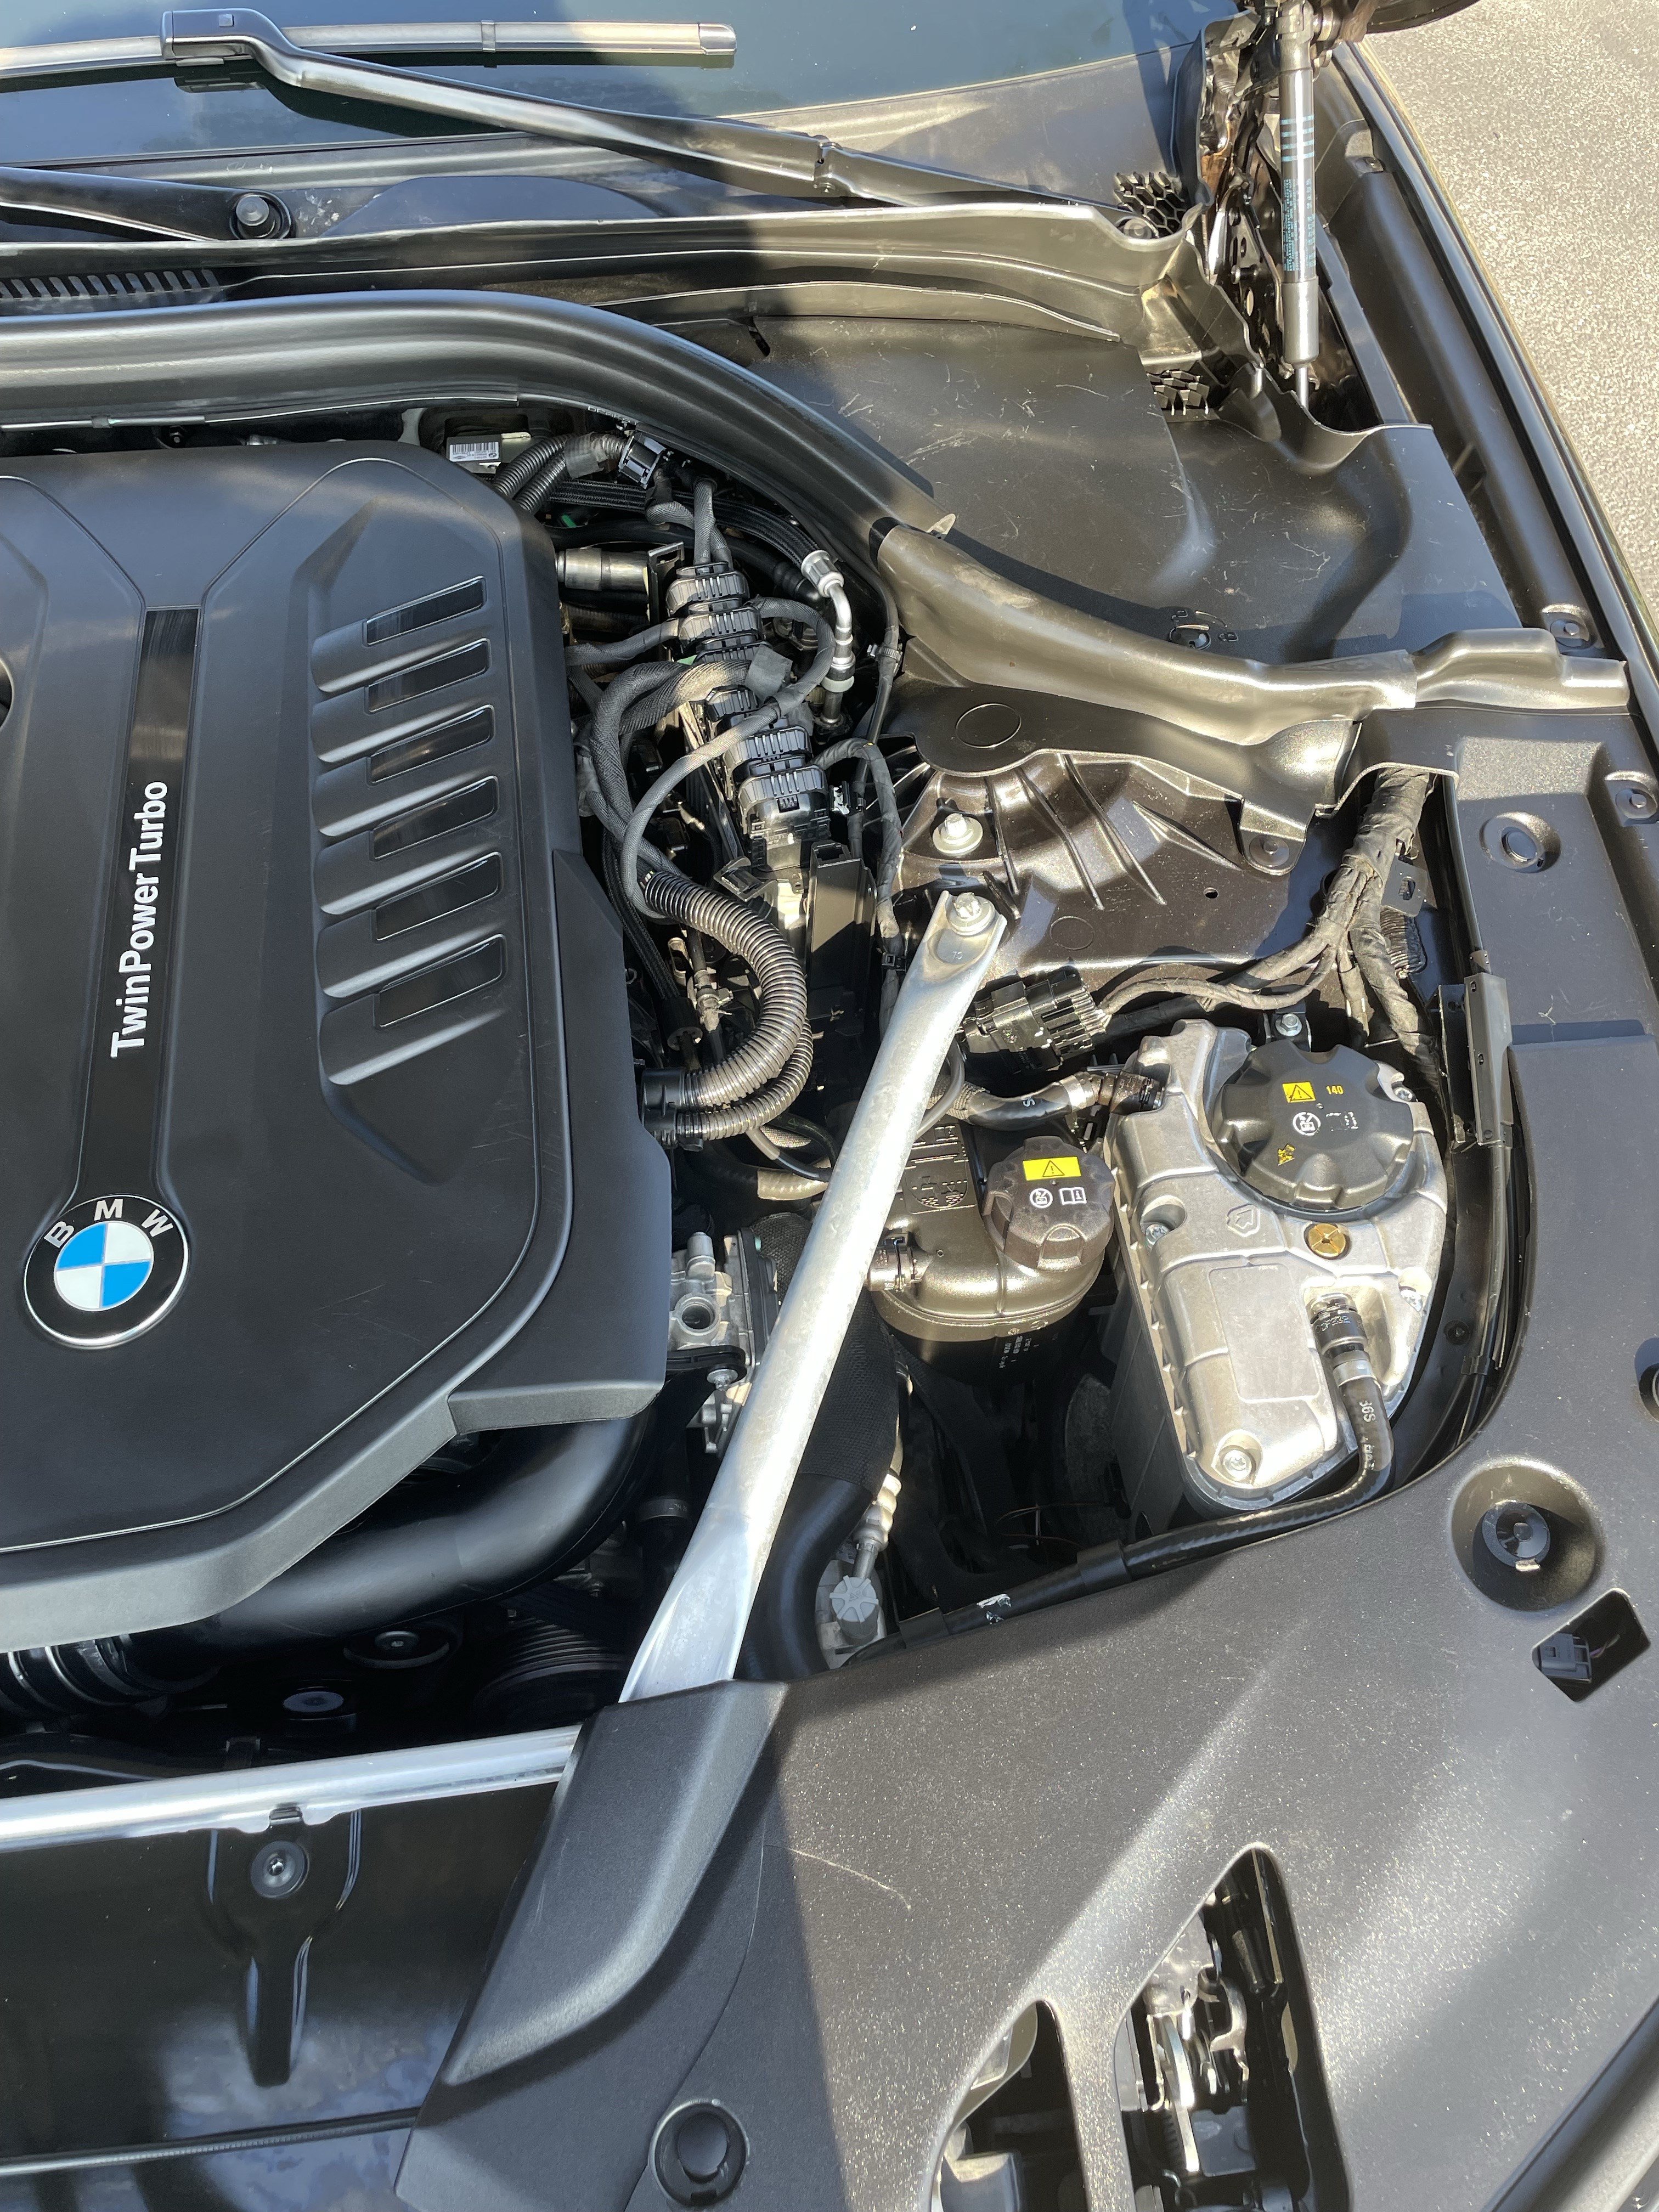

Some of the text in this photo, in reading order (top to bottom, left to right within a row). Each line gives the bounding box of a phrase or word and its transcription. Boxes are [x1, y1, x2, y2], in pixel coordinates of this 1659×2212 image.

[110, 781, 168, 1058] TwinPower Turbo
[1326, 1085, 1344, 1095] 140
[44, 1198, 174, 1248] BMW
